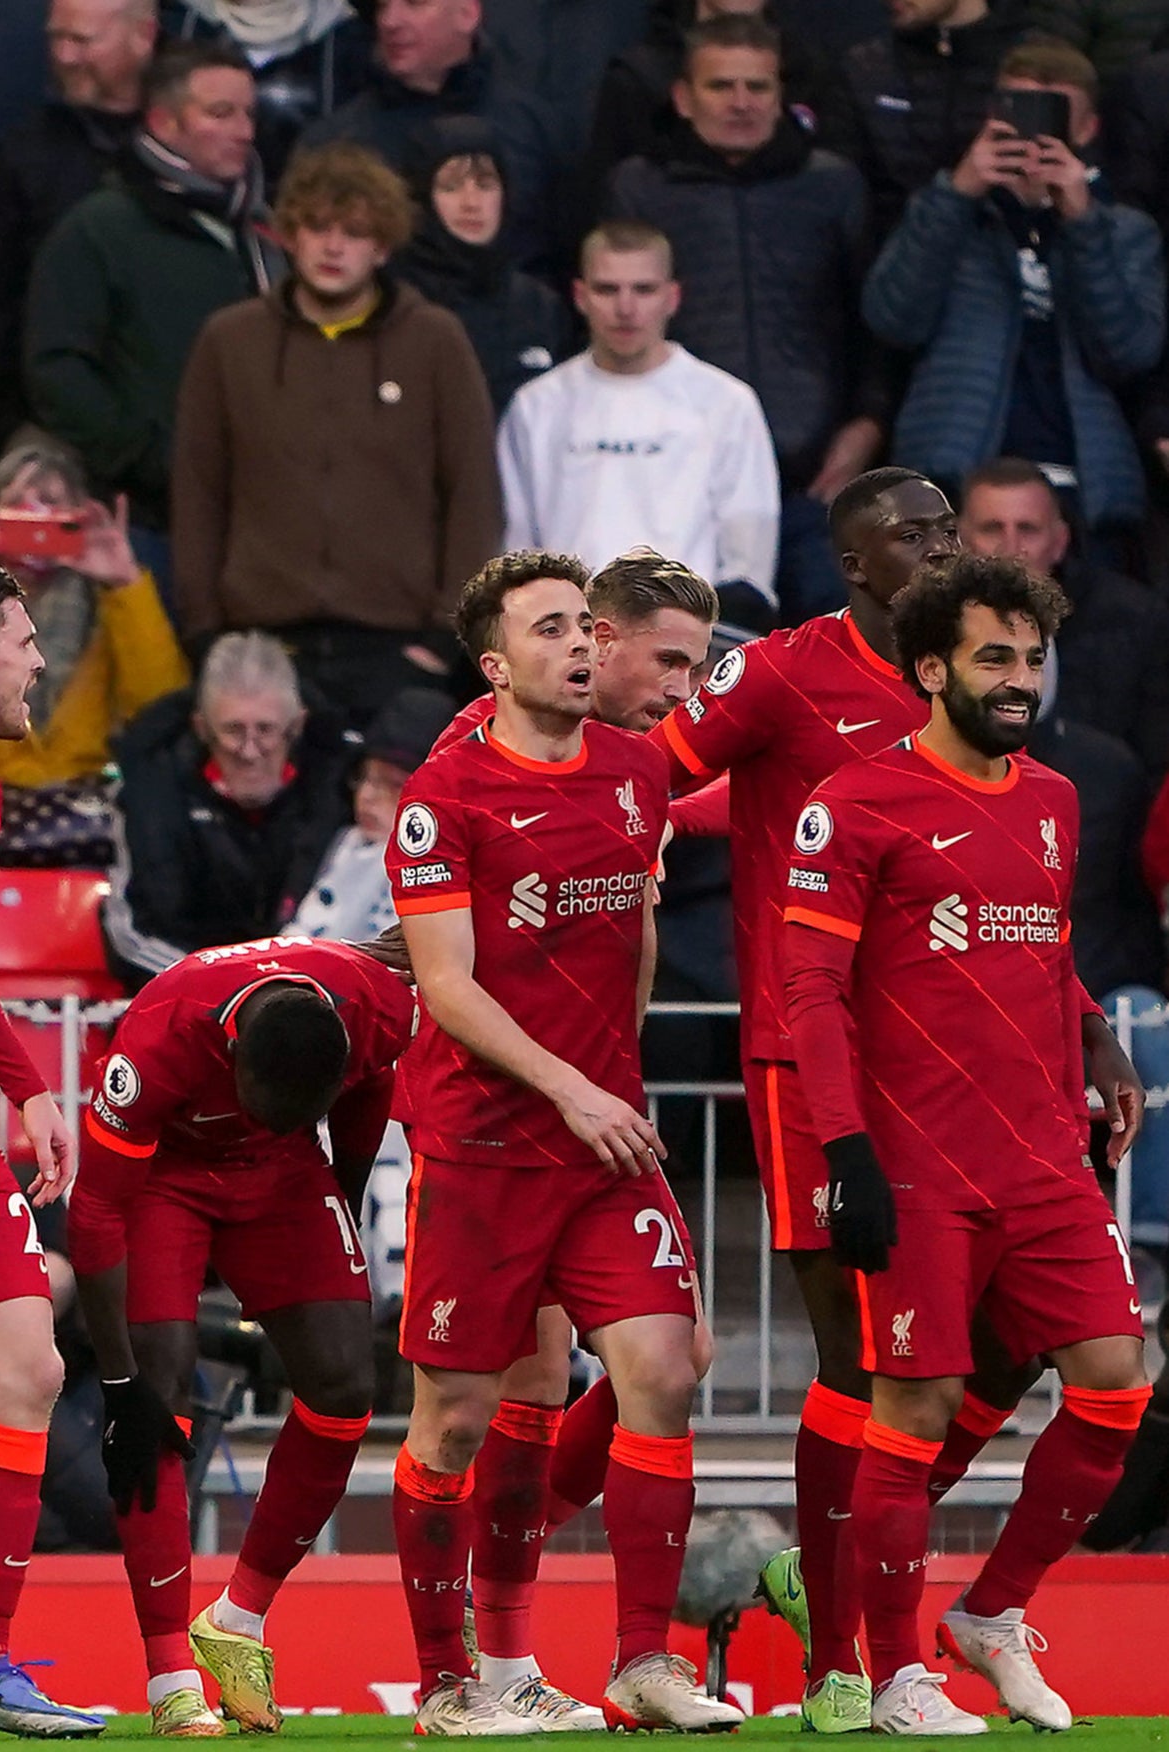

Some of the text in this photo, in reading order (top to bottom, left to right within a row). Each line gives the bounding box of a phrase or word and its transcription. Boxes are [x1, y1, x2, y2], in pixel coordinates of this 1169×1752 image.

[401, 864, 446, 877] No room
[634, 1208, 683, 1268] 2
